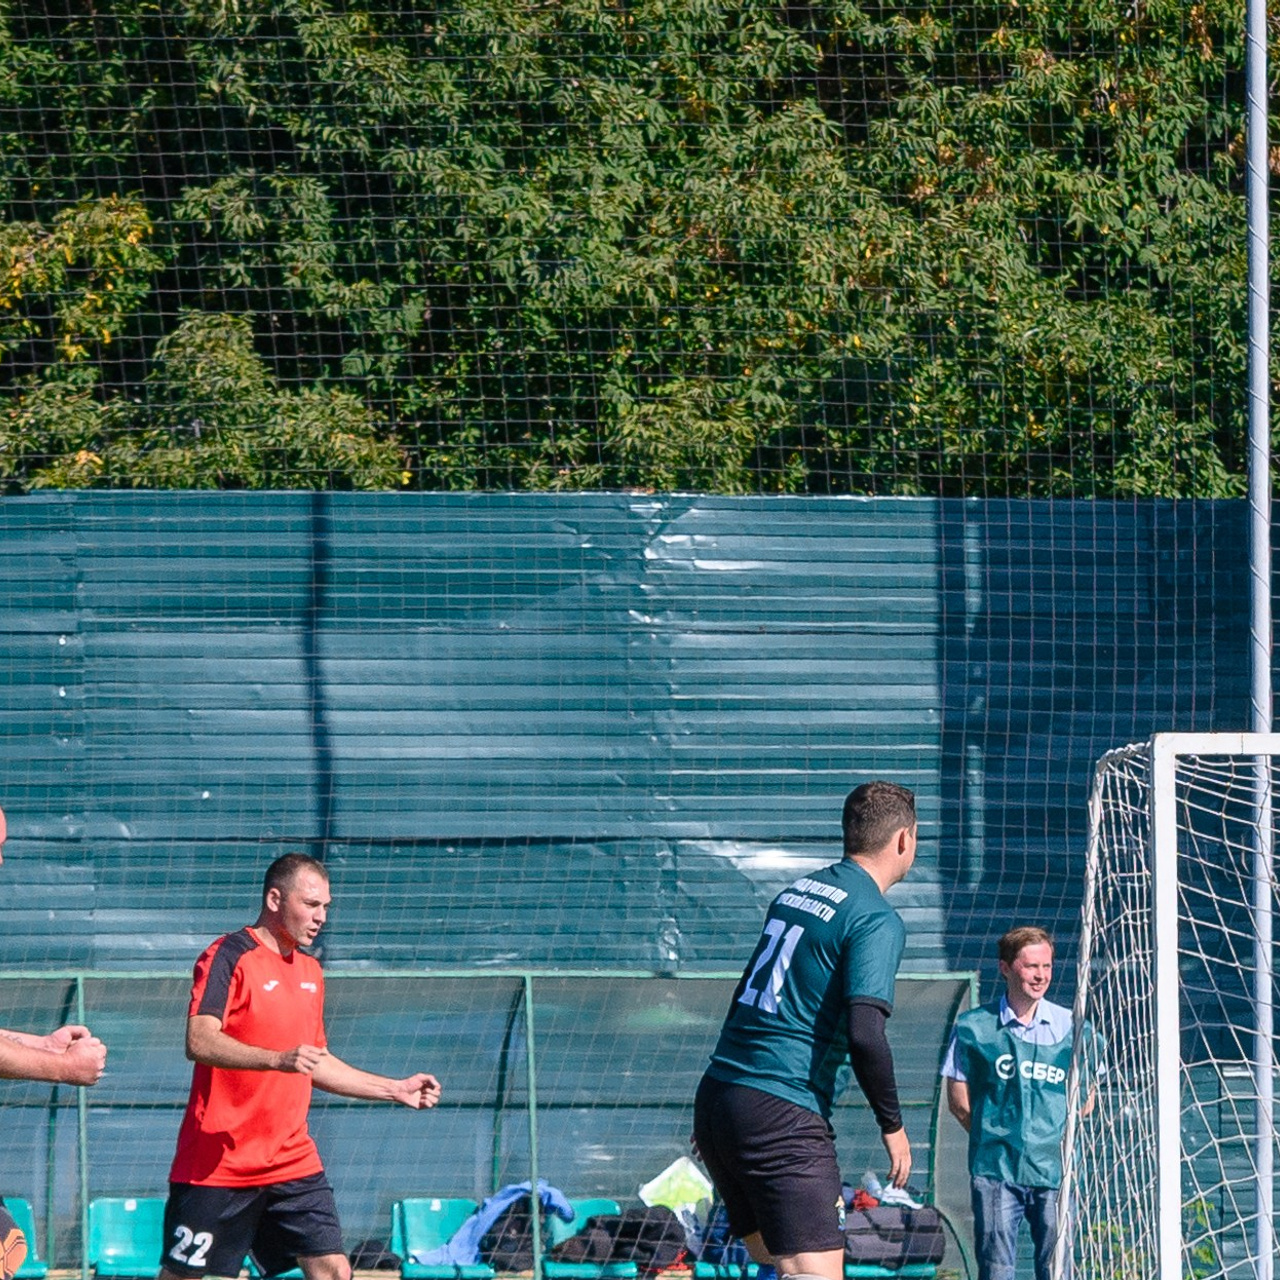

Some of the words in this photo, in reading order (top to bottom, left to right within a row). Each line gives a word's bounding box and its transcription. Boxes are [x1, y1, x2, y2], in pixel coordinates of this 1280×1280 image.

[738, 917, 805, 1014] 21
[1020, 1060, 1066, 1085] СБЕР
[169, 1225, 213, 1267] 22
